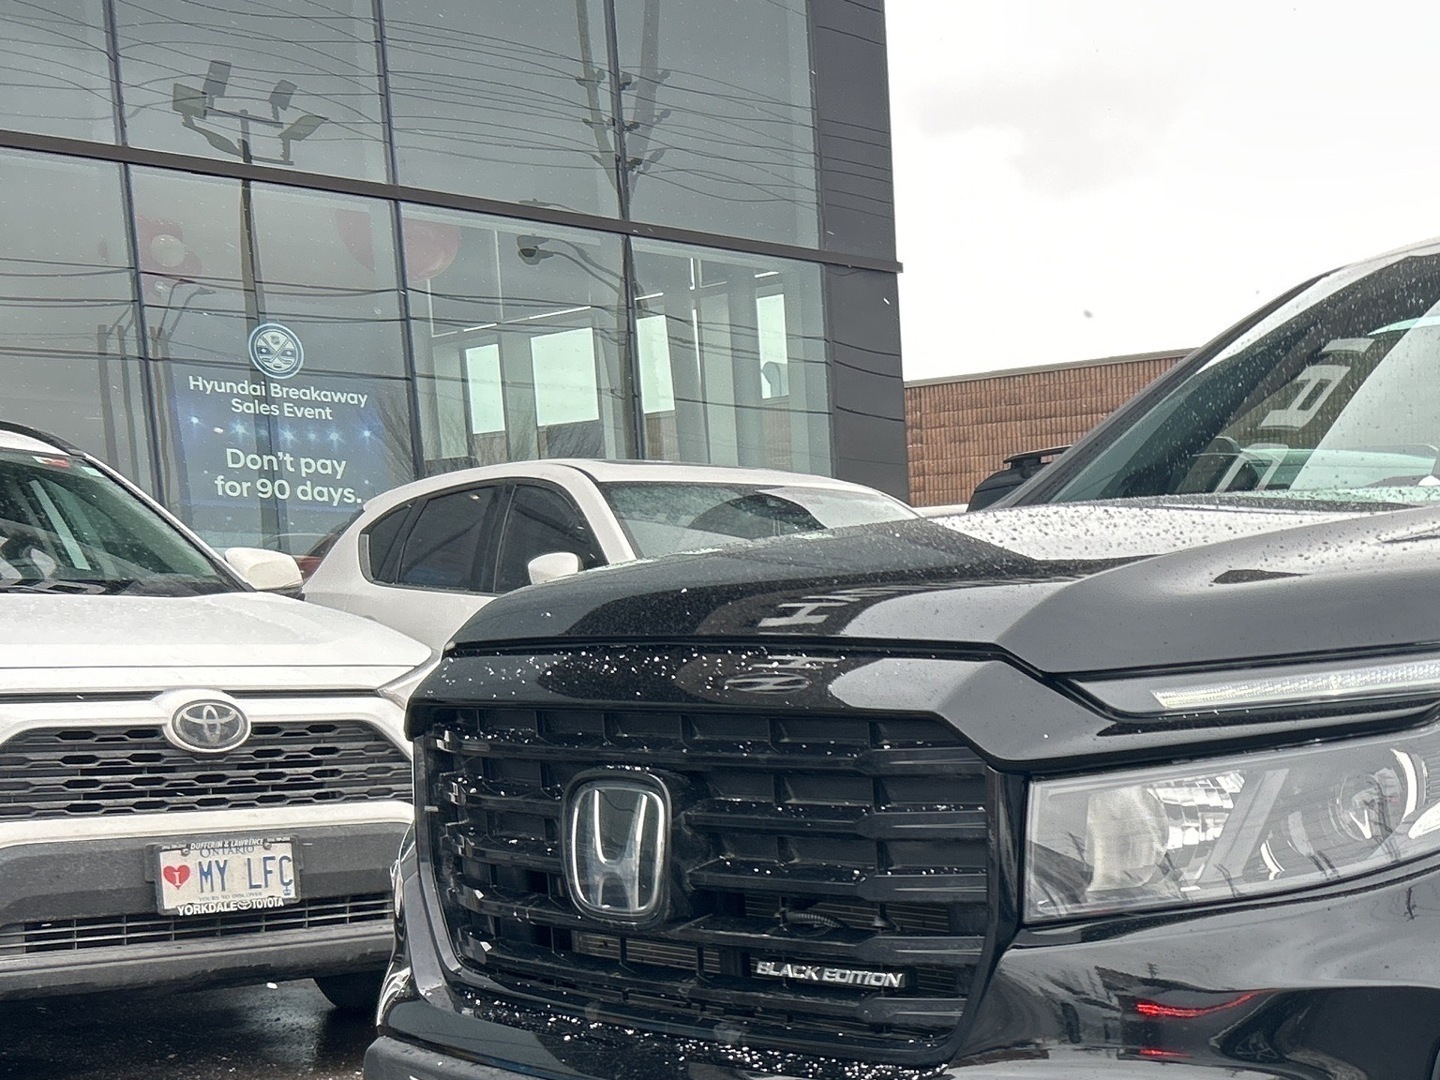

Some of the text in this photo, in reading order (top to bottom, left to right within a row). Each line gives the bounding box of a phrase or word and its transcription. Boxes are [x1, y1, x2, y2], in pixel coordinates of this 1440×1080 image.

[188, 375, 368, 407] Hyundai Breakaway
[231, 398, 333, 420] Sales Event
[226, 448, 347, 479] Don't pay
[214, 475, 363, 506] for 90 days.
[200, 845, 255, 859] ONTARIO
[198, 859, 228, 894] MY
[247, 855, 293, 890] LFC
[177, 897, 285, 916] YORKDALE TOYOTA
[756, 961, 904, 988] BLACK EDITION
